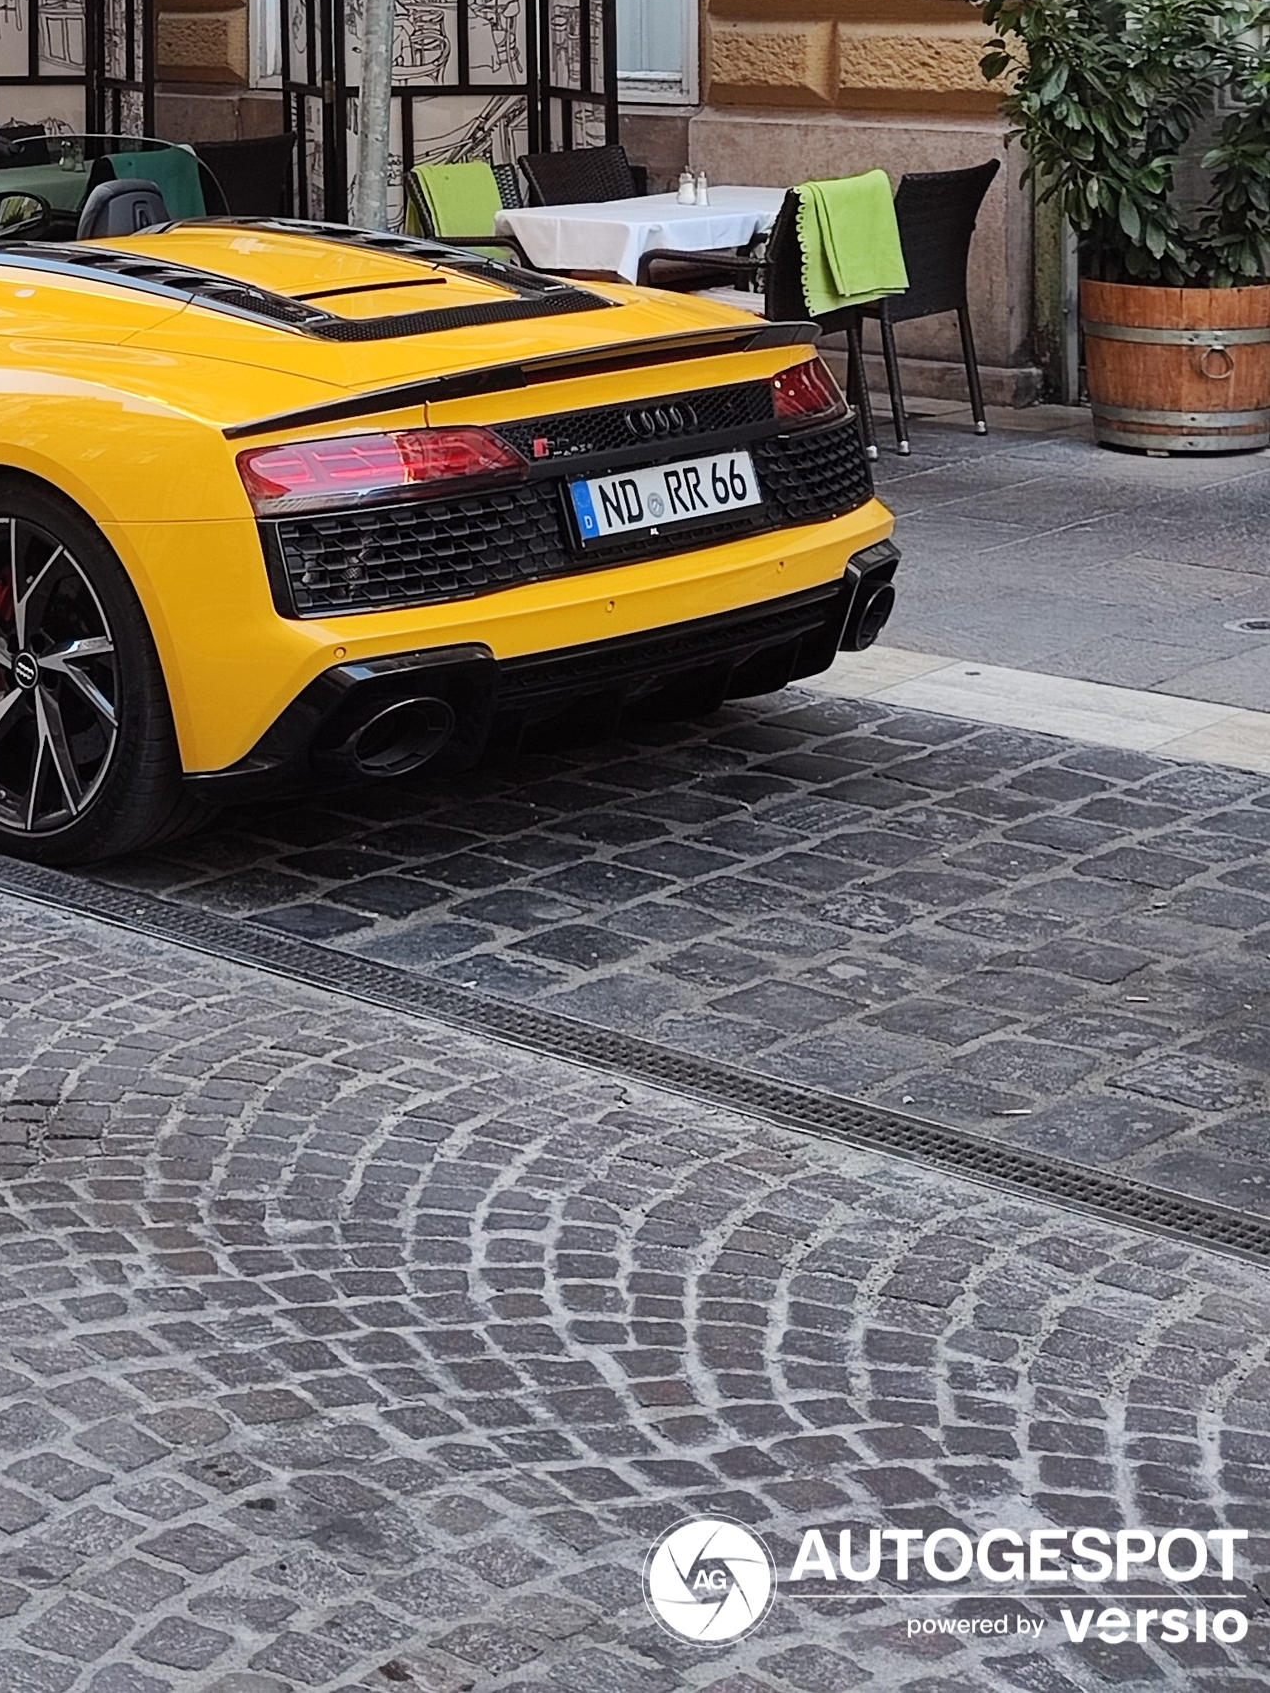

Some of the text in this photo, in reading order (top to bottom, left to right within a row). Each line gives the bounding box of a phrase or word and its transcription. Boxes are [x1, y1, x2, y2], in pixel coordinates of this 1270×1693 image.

[584, 459, 748, 529] D ND RR 66
